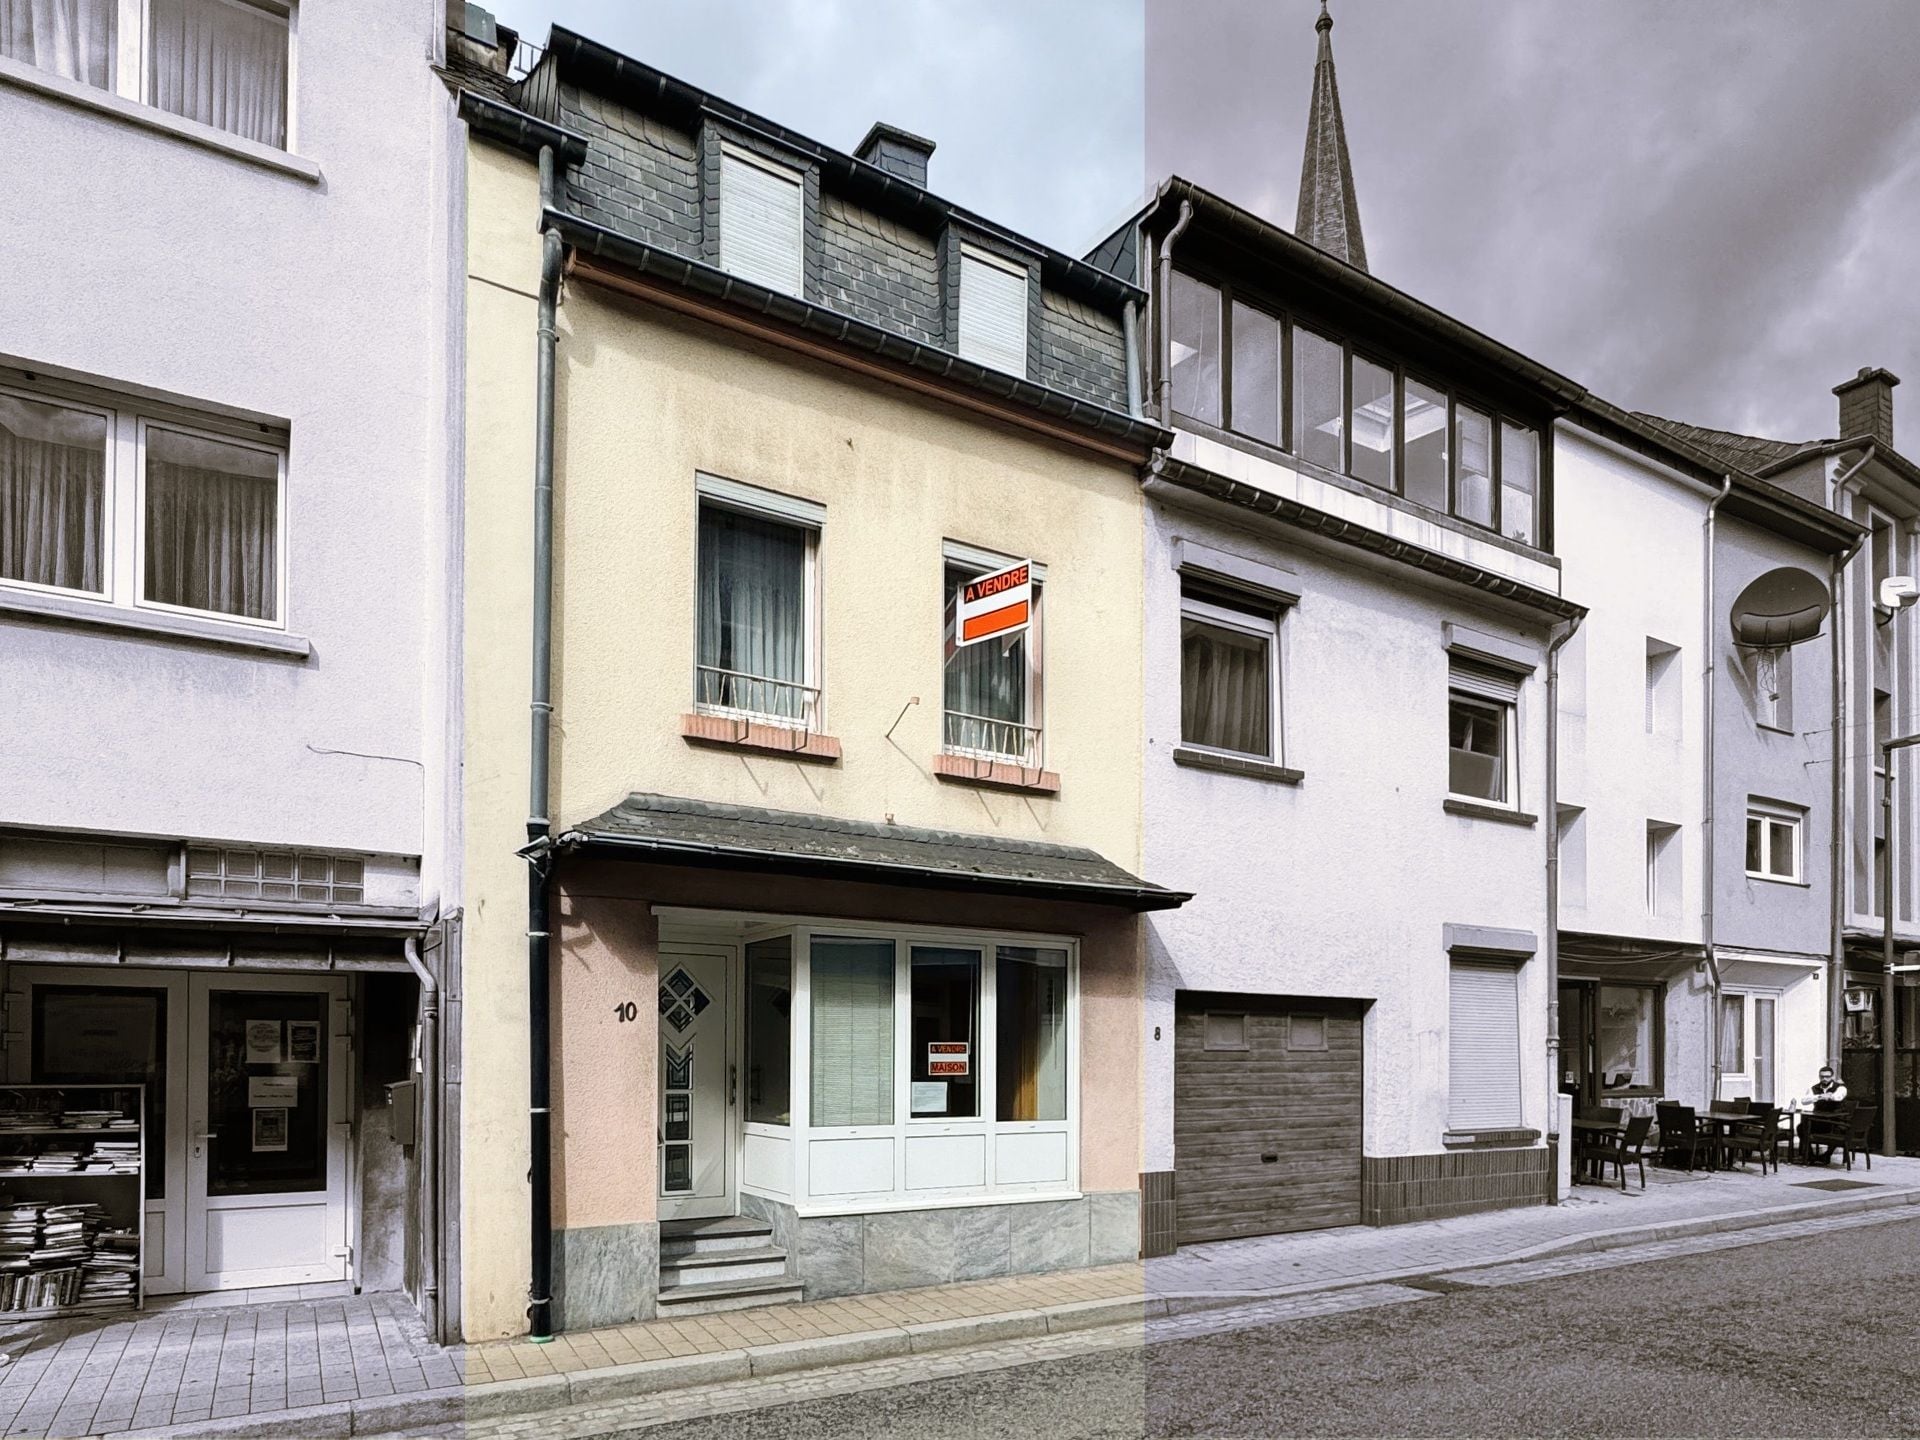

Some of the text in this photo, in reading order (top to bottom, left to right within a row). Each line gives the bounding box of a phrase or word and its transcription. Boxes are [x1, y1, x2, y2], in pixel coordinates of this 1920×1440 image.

[966, 566, 1028, 602] A VENDRE
[614, 1001, 637, 1023] 10
[1154, 1026, 1161, 1041] 8
[938, 1045, 965, 1053] VENDRE
[932, 1063, 965, 1072] MAISON
